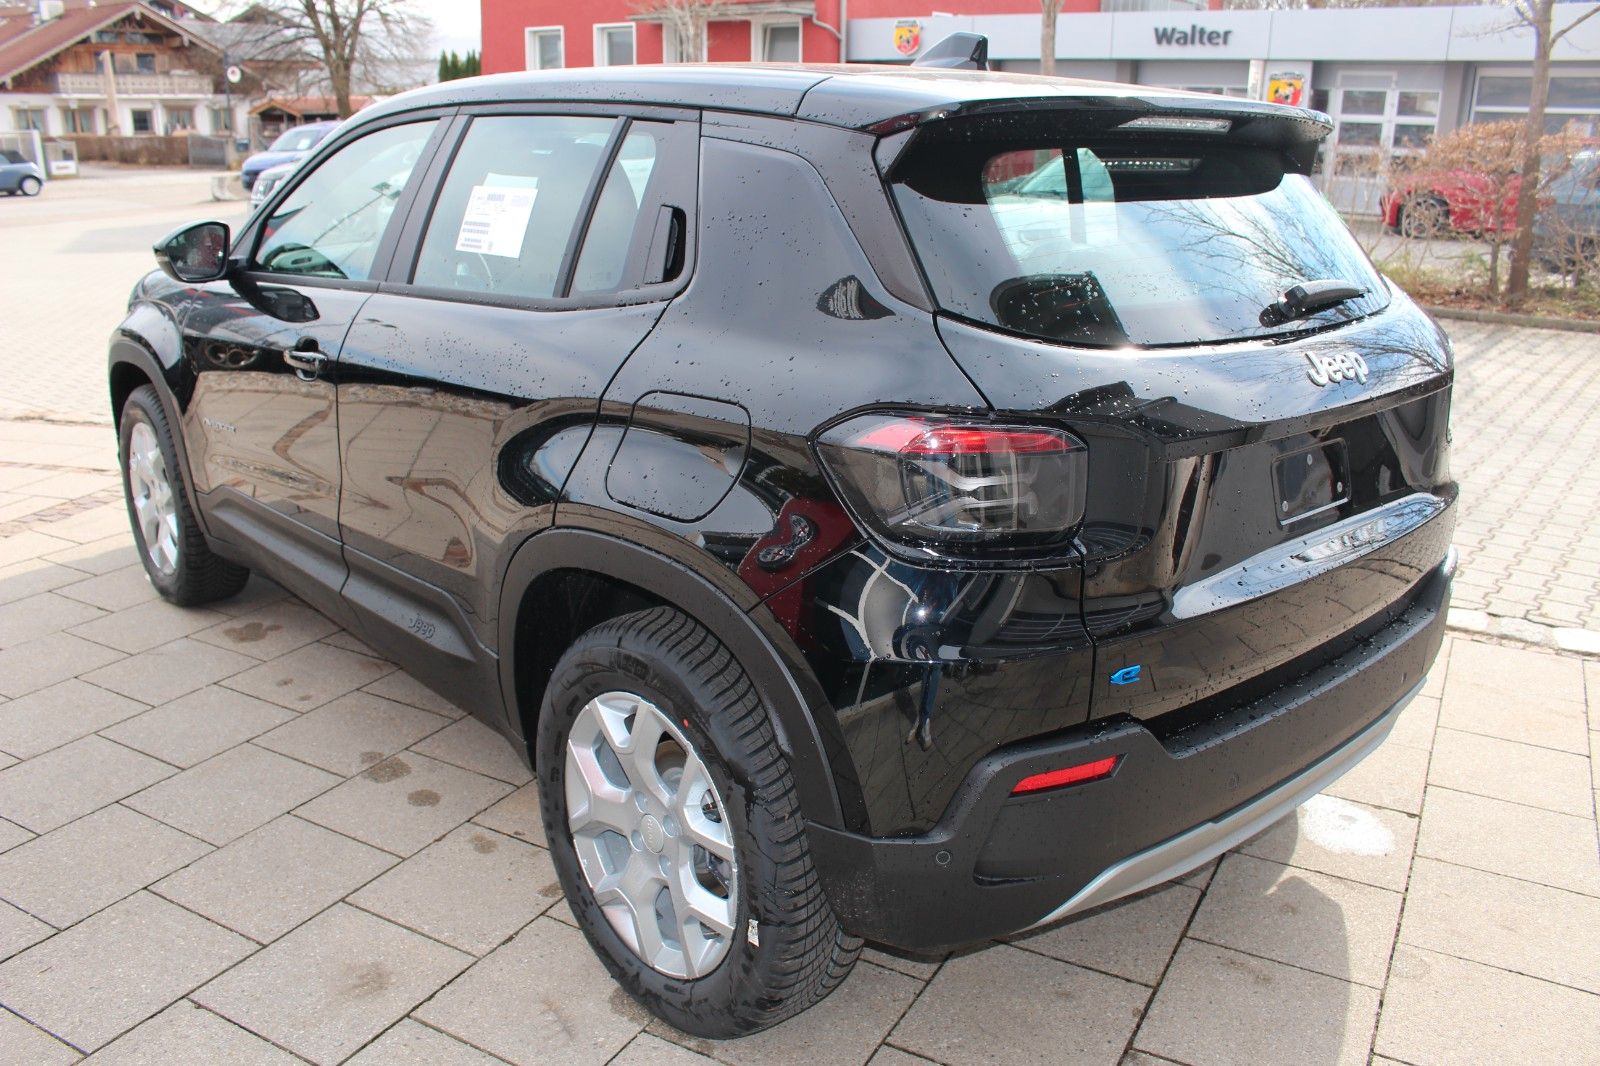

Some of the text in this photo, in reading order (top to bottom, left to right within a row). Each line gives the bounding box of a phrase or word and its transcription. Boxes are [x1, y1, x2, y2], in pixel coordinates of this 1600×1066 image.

[1154, 24, 1233, 46] Walter
[1305, 351, 1369, 387] Jeep
[408, 615, 436, 639] Jeep
